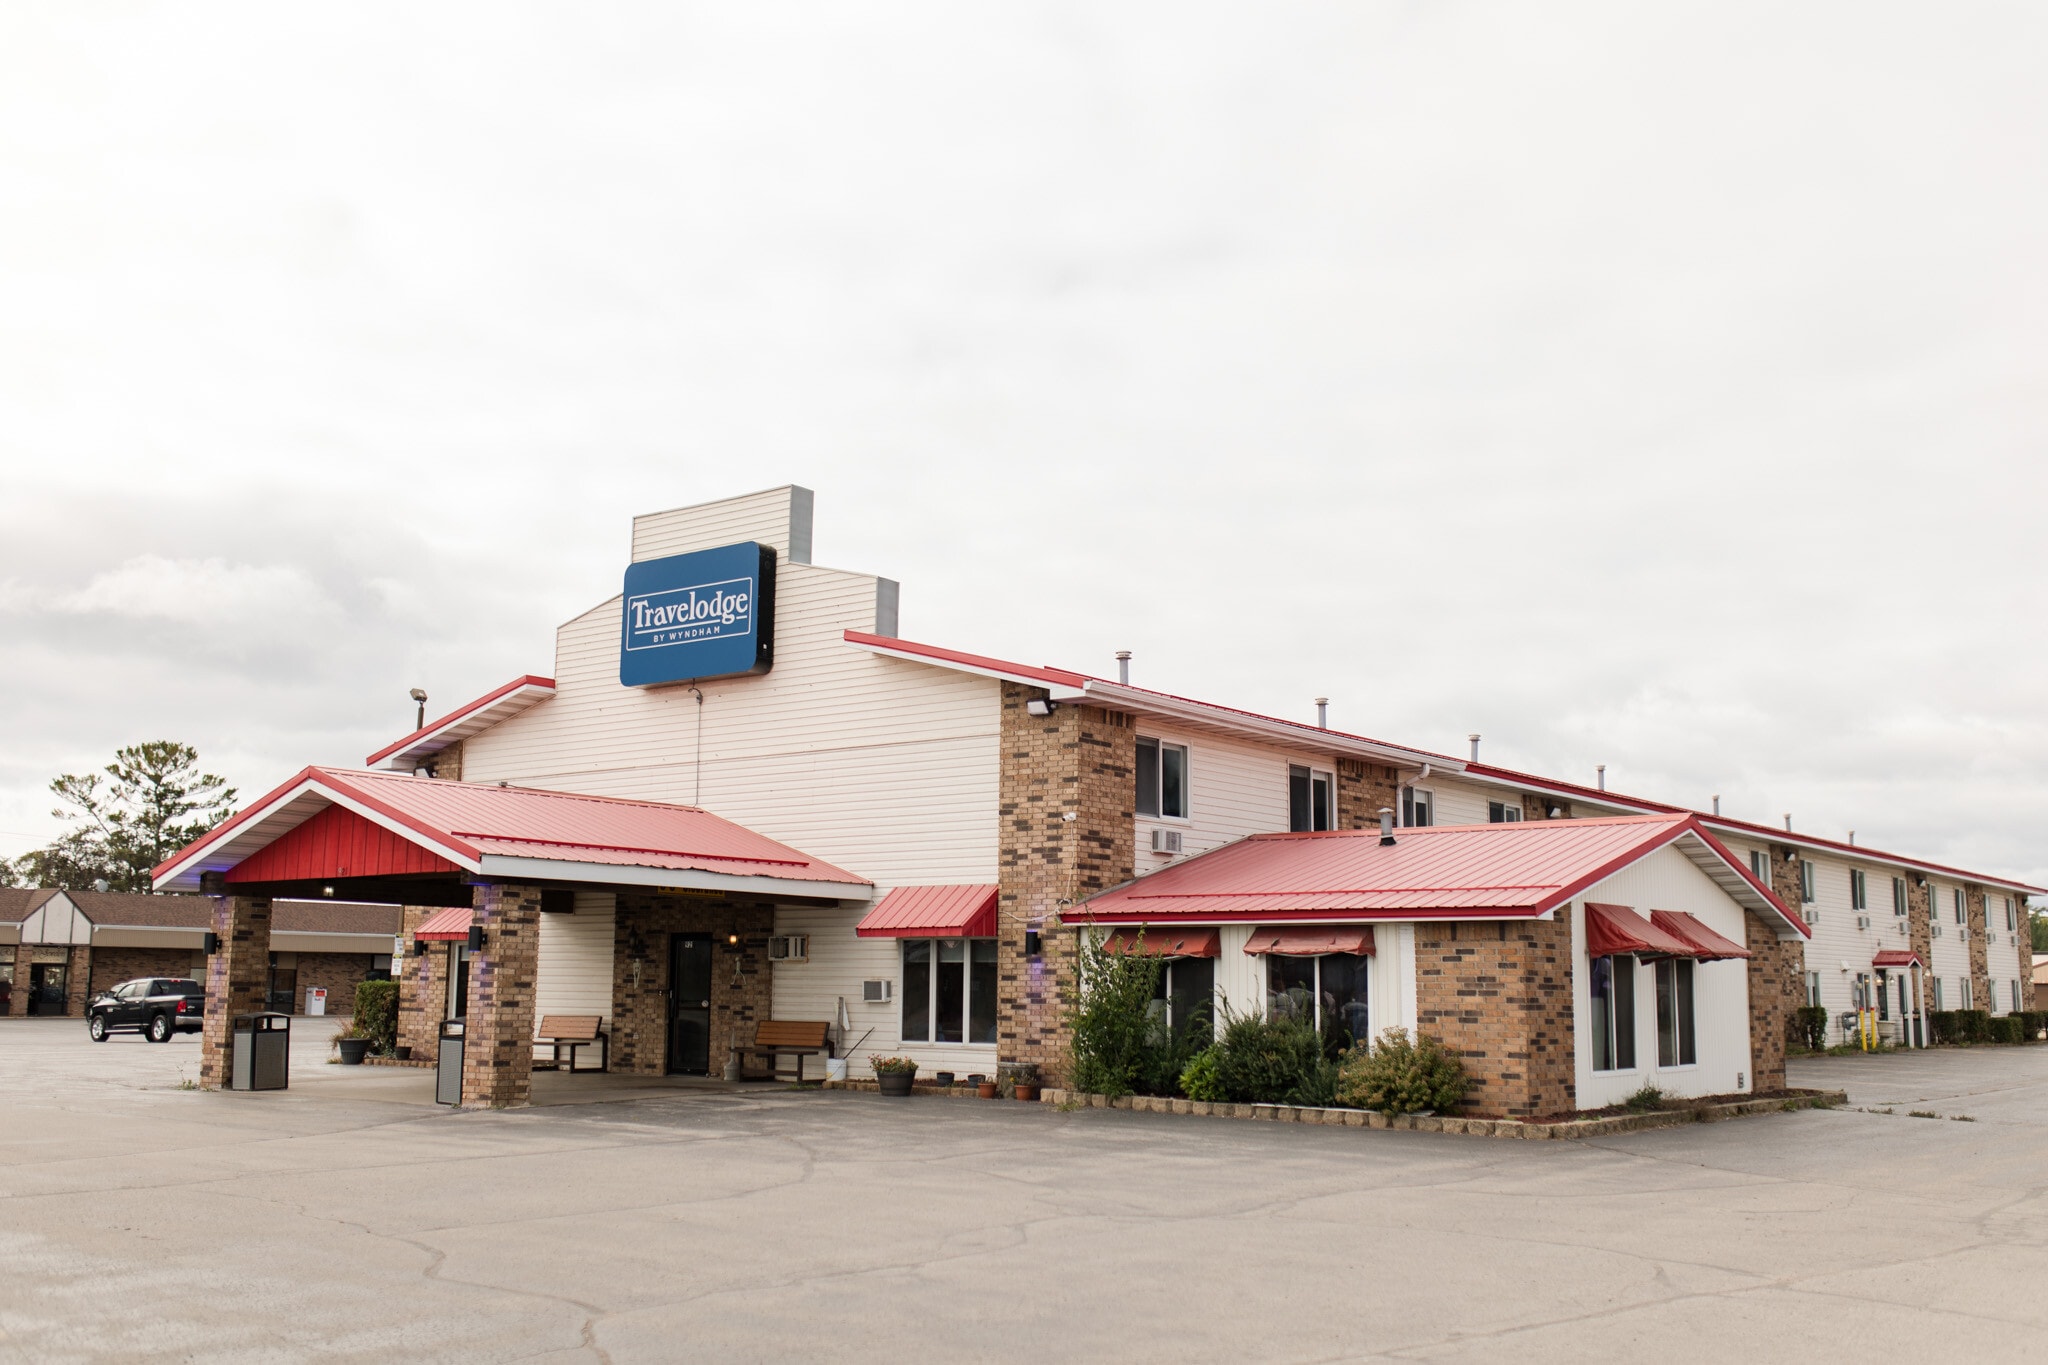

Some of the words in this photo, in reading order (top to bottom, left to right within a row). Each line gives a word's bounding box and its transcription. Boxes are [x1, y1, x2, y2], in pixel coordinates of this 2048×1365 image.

[631, 590, 748, 629] Travelodge
[653, 634, 665, 643] BY
[669, 626, 720, 640] WYNDHAM
